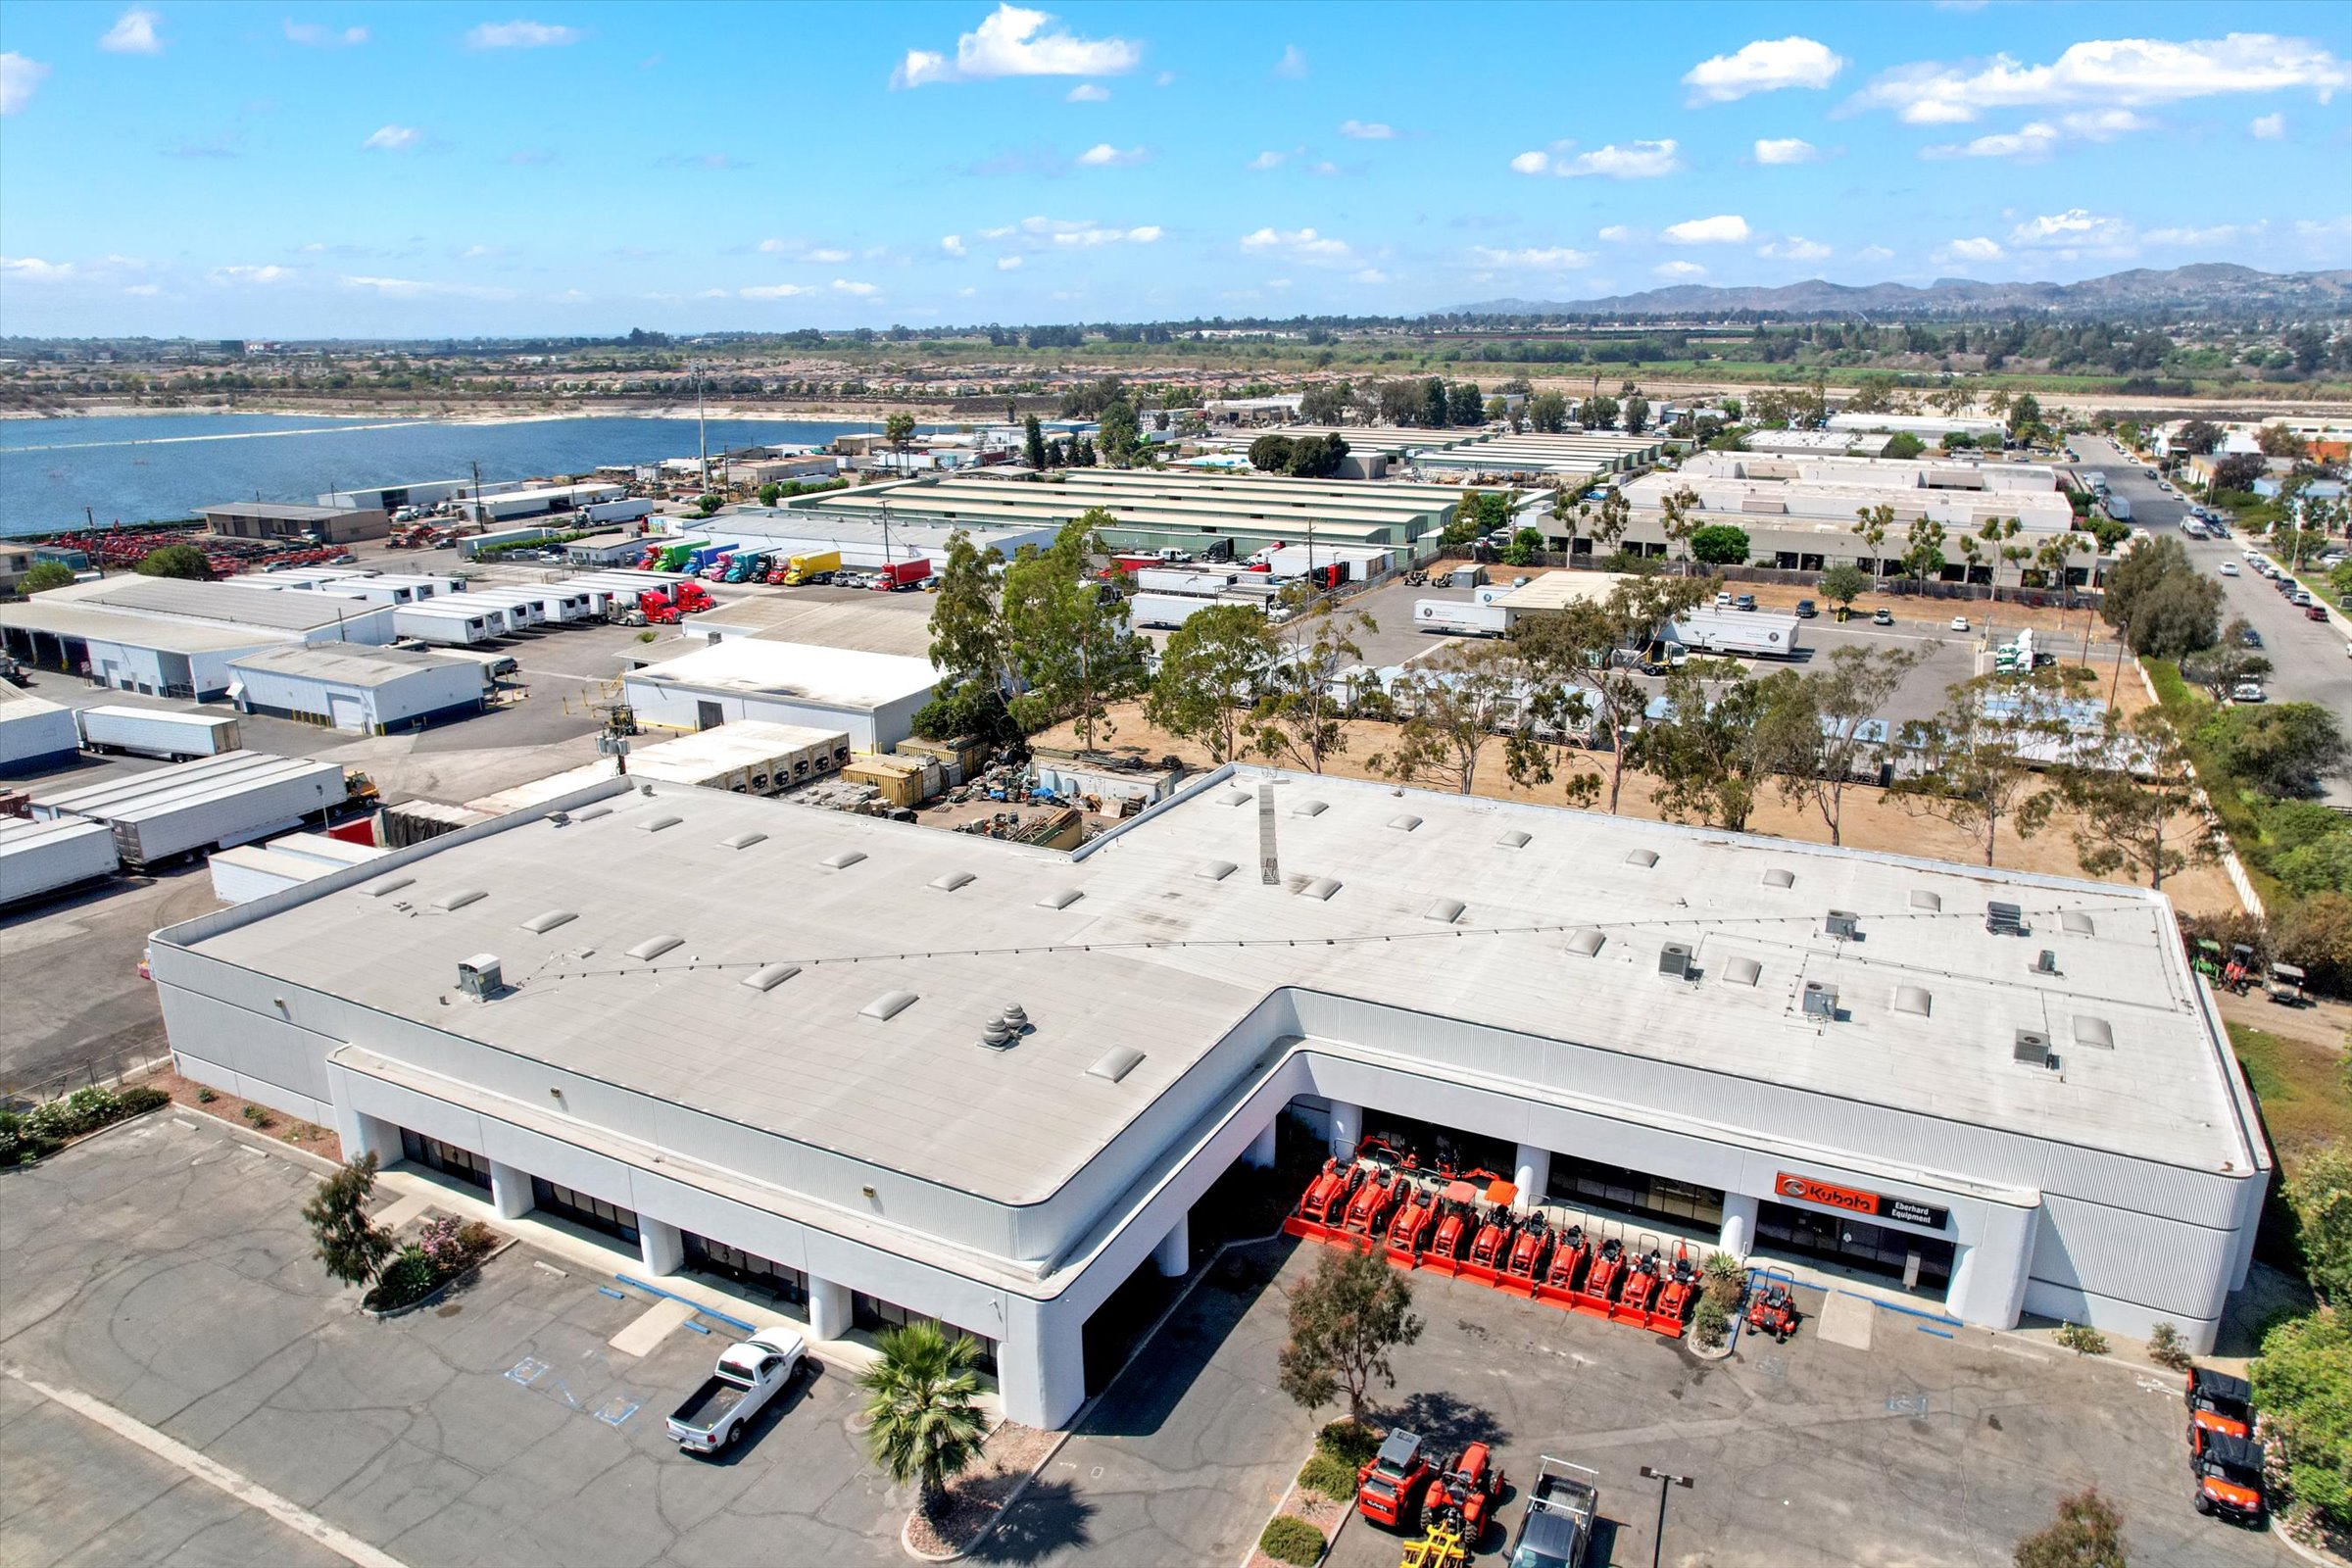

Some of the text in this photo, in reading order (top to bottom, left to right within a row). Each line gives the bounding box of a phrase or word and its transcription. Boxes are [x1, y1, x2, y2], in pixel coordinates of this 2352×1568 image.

[1810, 1186, 1871, 1210] Kubota
[1895, 1201, 1929, 1215] Eberhard
[1891, 1209, 1931, 1223] Equipment
